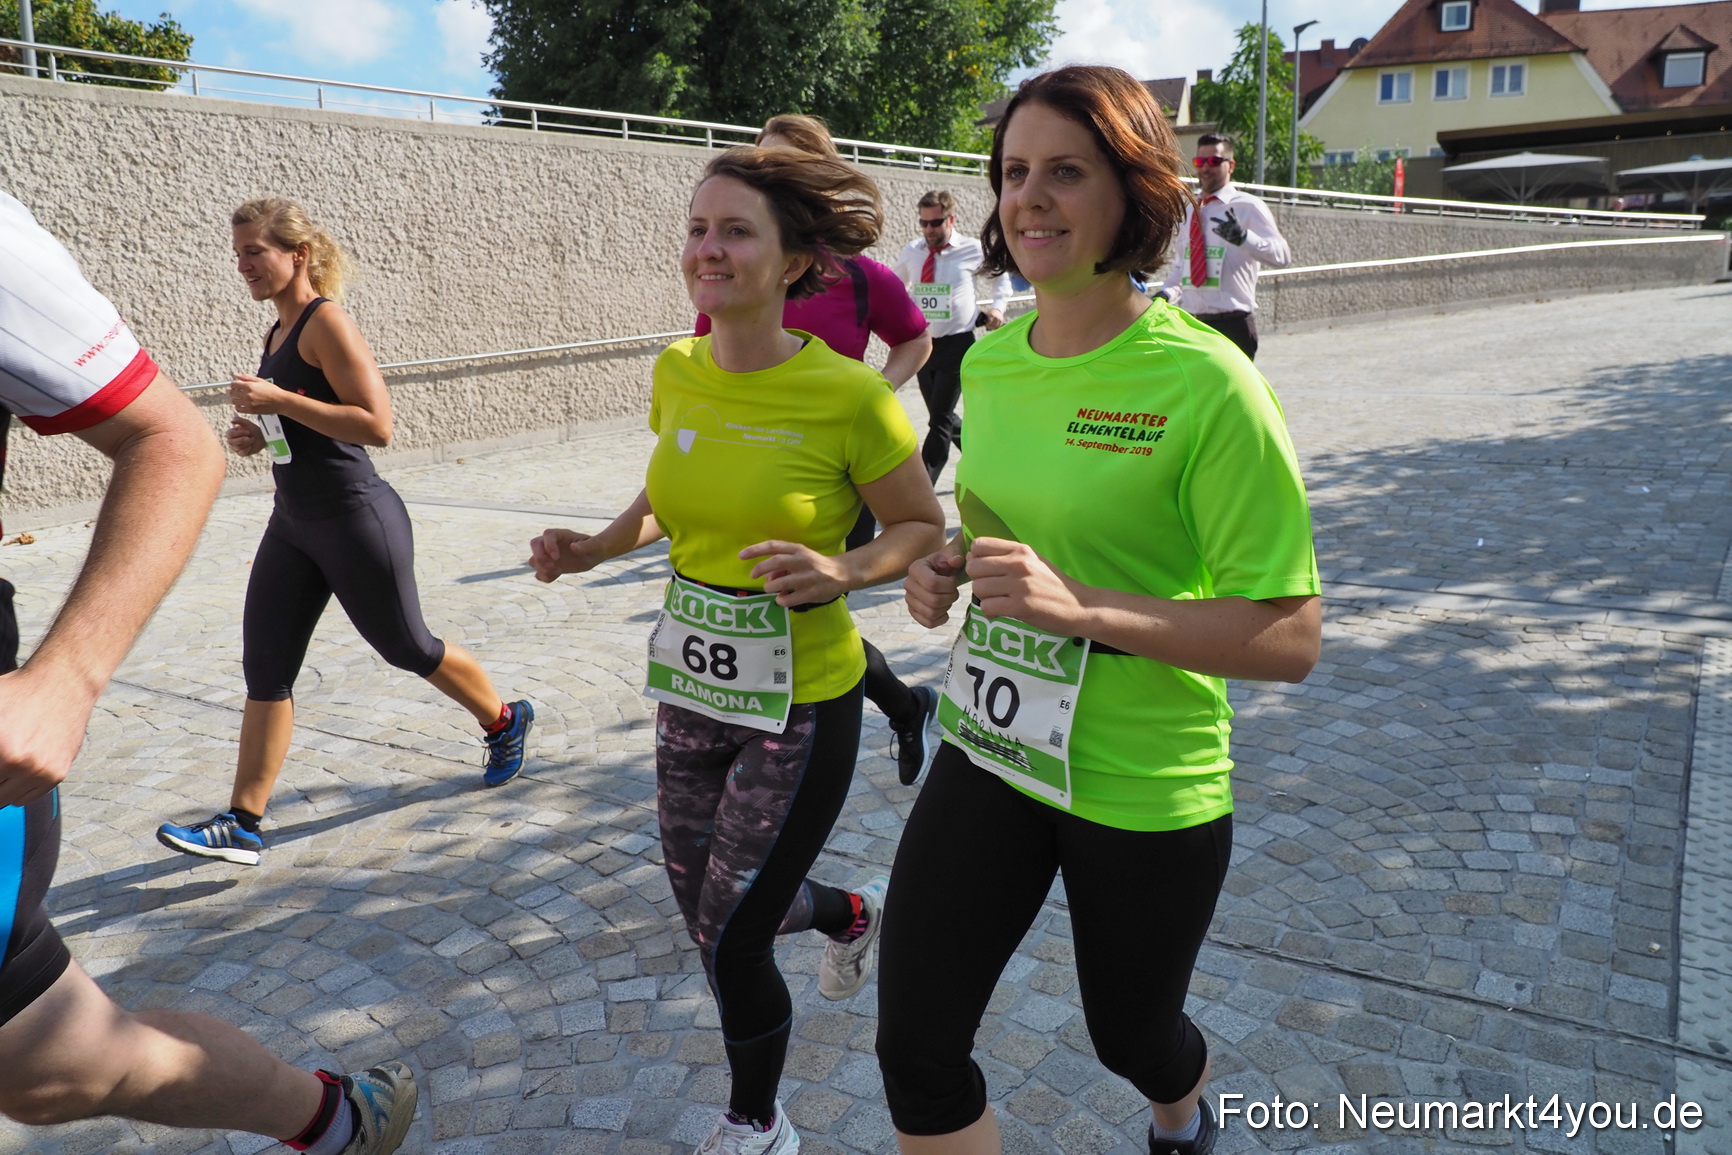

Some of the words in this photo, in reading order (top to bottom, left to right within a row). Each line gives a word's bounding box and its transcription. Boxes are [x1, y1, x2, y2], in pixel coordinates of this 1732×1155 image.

[921, 297, 937, 309] 90
[1077, 408, 1168, 427] NEUMARKTER
[1067, 422, 1165, 442] ELEMENTELAUF
[1076, 439, 1129, 454] September
[1129, 446, 1153, 456] 2019
[774, 648, 786, 656] E6
[968, 612, 1068, 678] OCK
[682, 634, 738, 681] 68
[671, 673, 763, 711] RAMONA
[965, 662, 1021, 729] 70
[1060, 699, 1071, 711] E6
[963, 704, 1025, 748] MARINA
